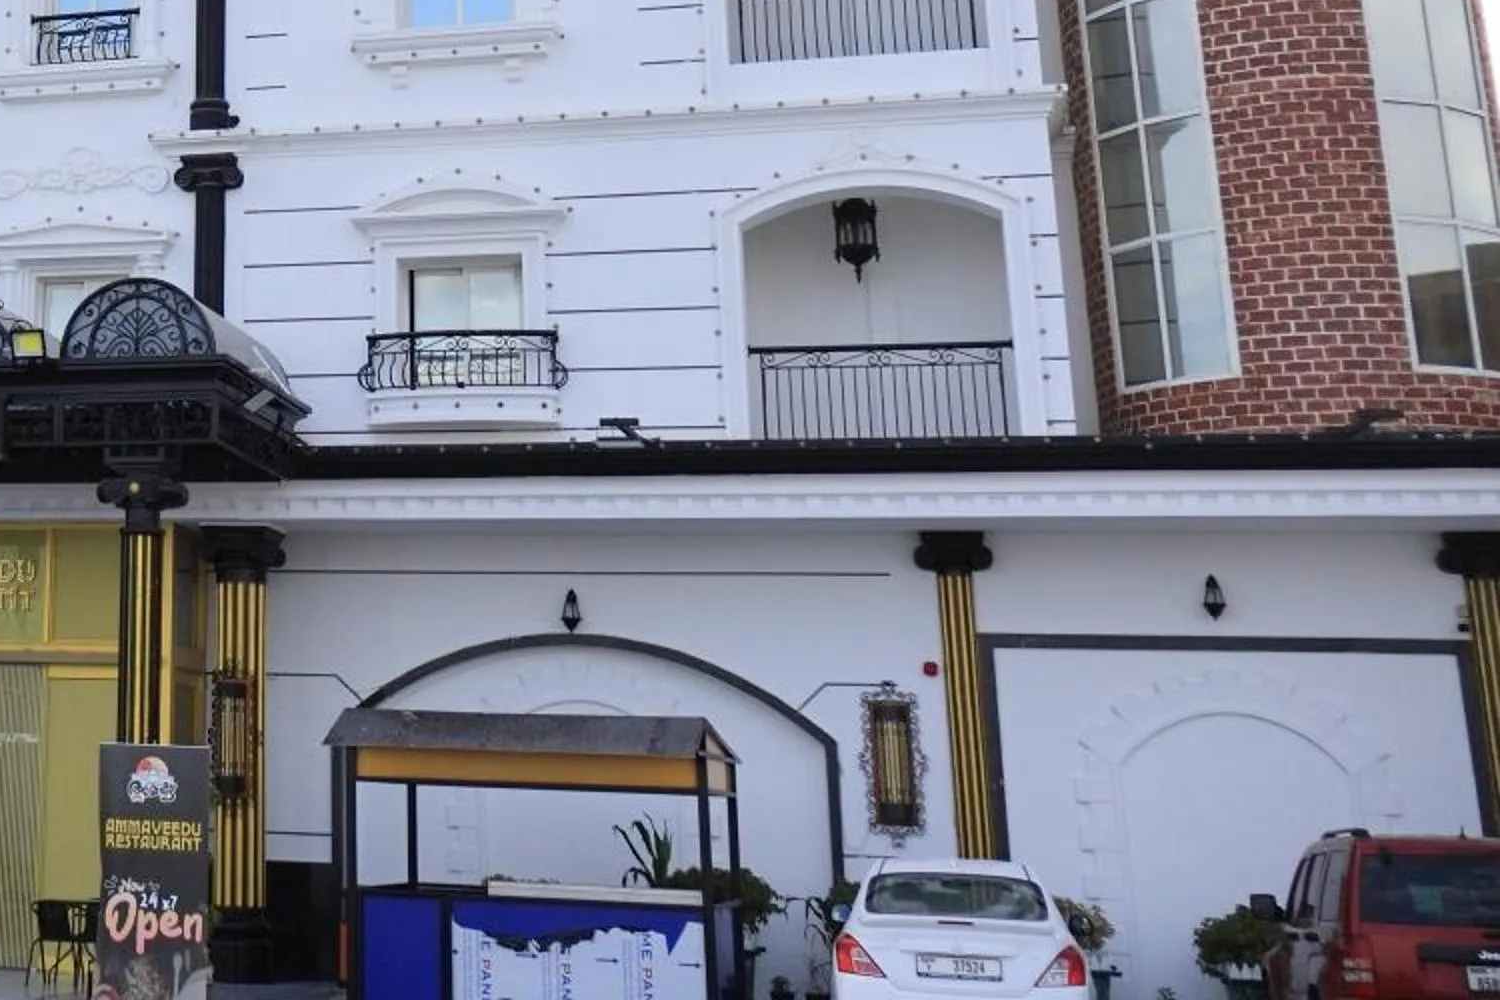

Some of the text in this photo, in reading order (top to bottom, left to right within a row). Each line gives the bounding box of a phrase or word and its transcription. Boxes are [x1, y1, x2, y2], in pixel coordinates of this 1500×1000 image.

[105, 819, 201, 837] AMMAVEEDU
[105, 834, 202, 852] RESTAURANT
[105, 891, 203, 954] Open
[481, 959, 492, 1000] PAN
